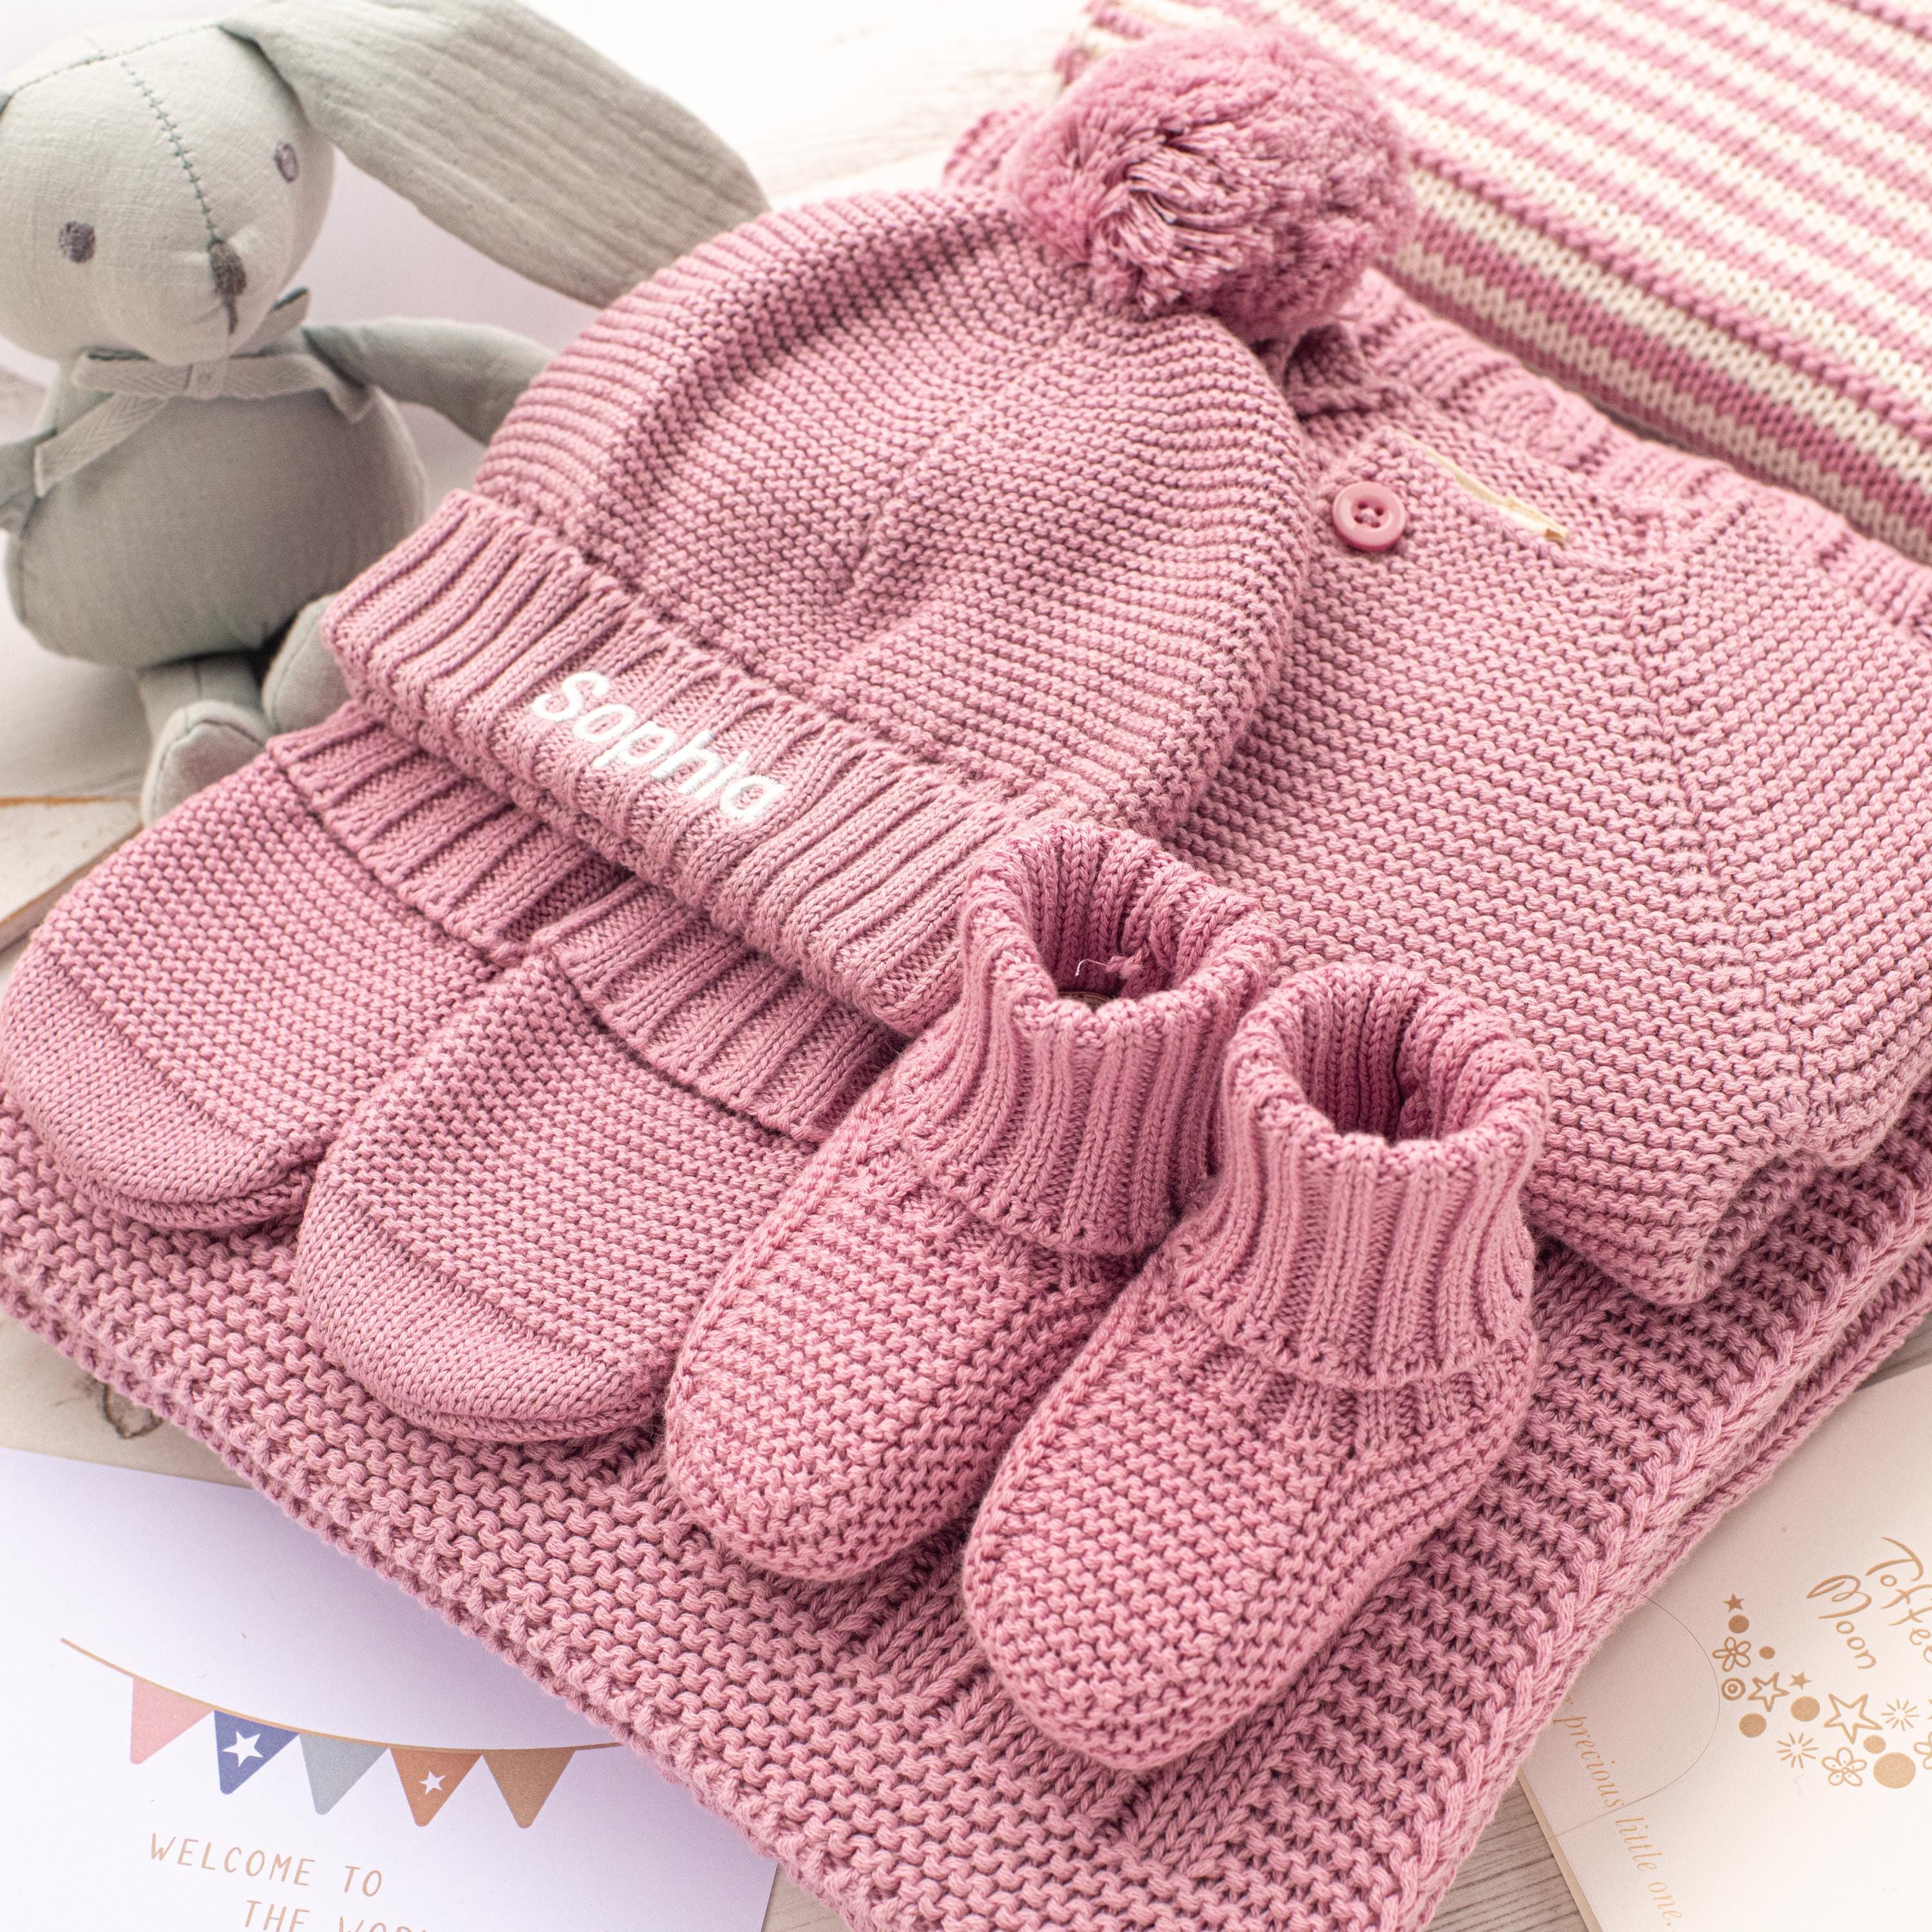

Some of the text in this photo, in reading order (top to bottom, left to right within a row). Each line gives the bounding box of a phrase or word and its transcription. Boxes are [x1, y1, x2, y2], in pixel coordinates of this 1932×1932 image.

[531, 671, 786, 822] Sophia
[1806, 1574, 1877, 1669] Moon
[1552, 1715, 1625, 1808] precious
[1615, 1815, 1662, 1871] little
[149, 1832, 383, 1897] WELCOME TO
[244, 1900, 310, 1932] THE
